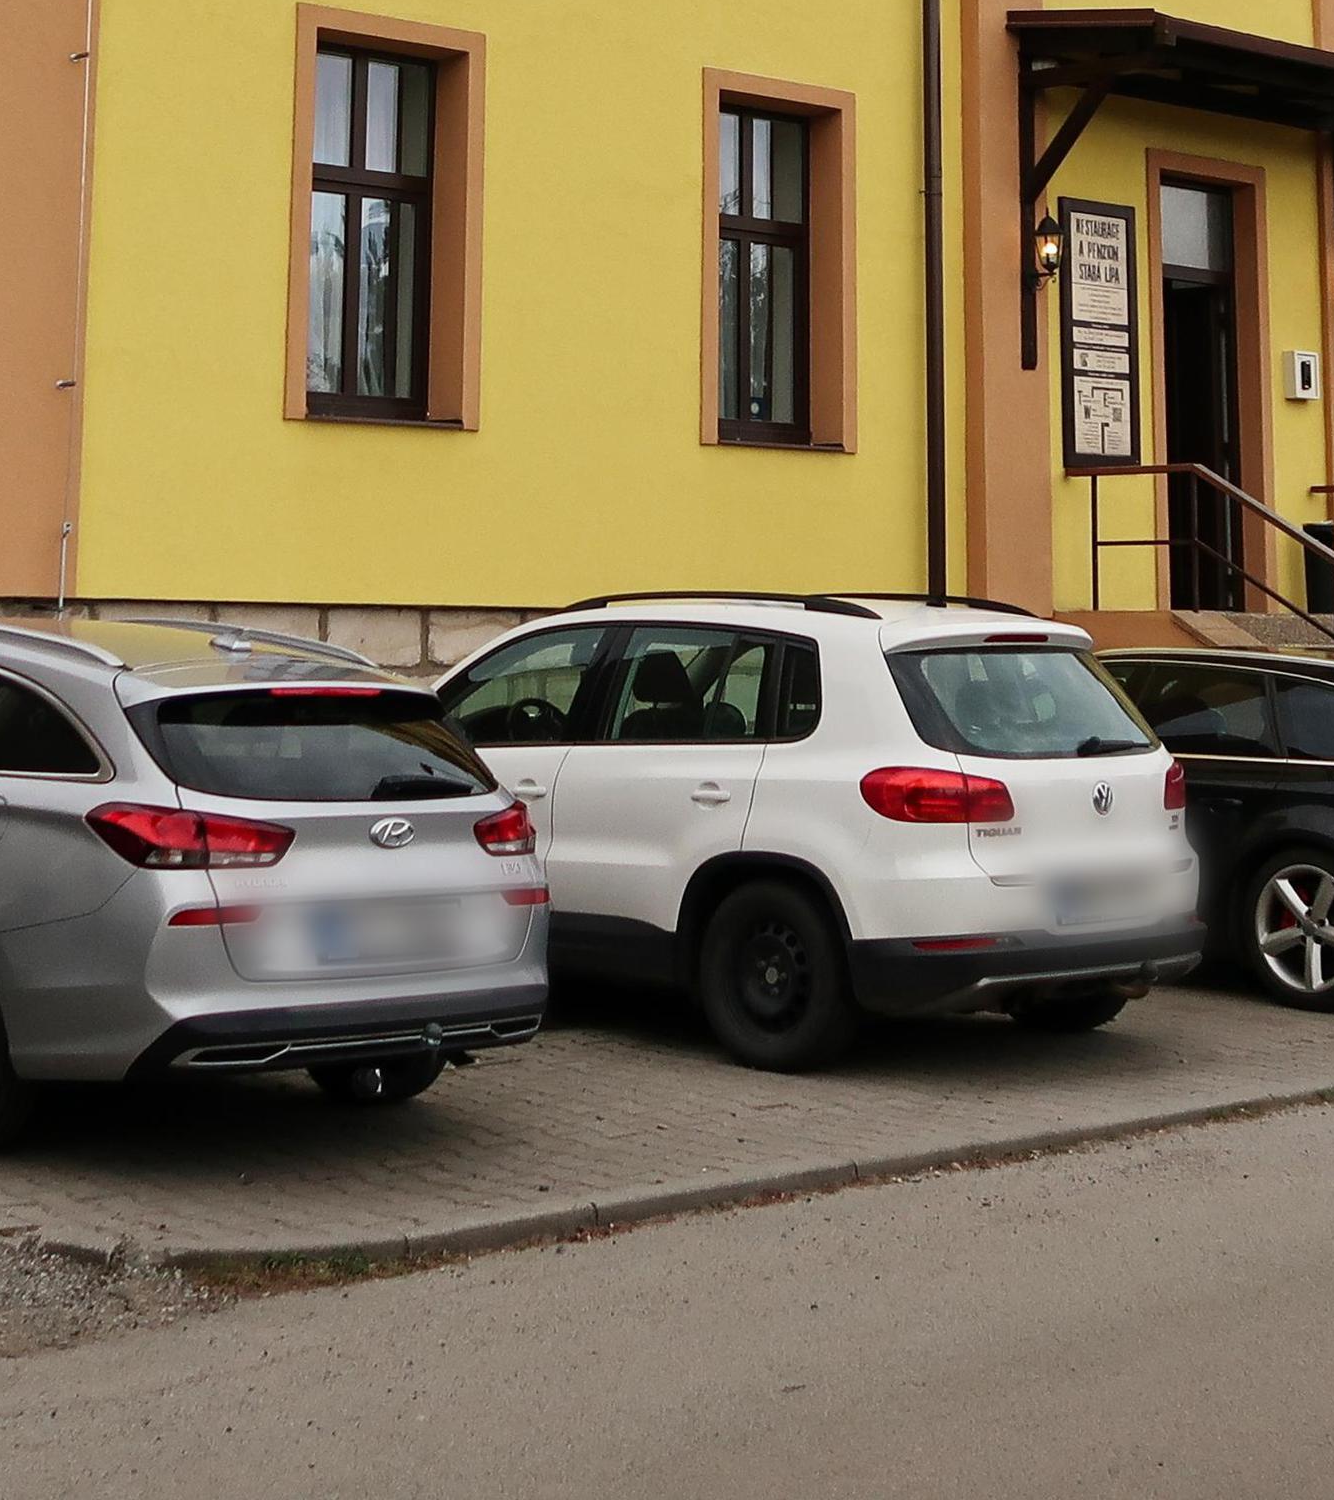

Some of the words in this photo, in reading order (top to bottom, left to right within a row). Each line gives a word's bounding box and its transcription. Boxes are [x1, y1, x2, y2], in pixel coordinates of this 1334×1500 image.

[1075, 218, 1120, 240] RESTAURACE
[1078, 240, 1085, 258] A
[1087, 241, 1119, 262] PENZION
[1079, 262, 1102, 283] STARÁ
